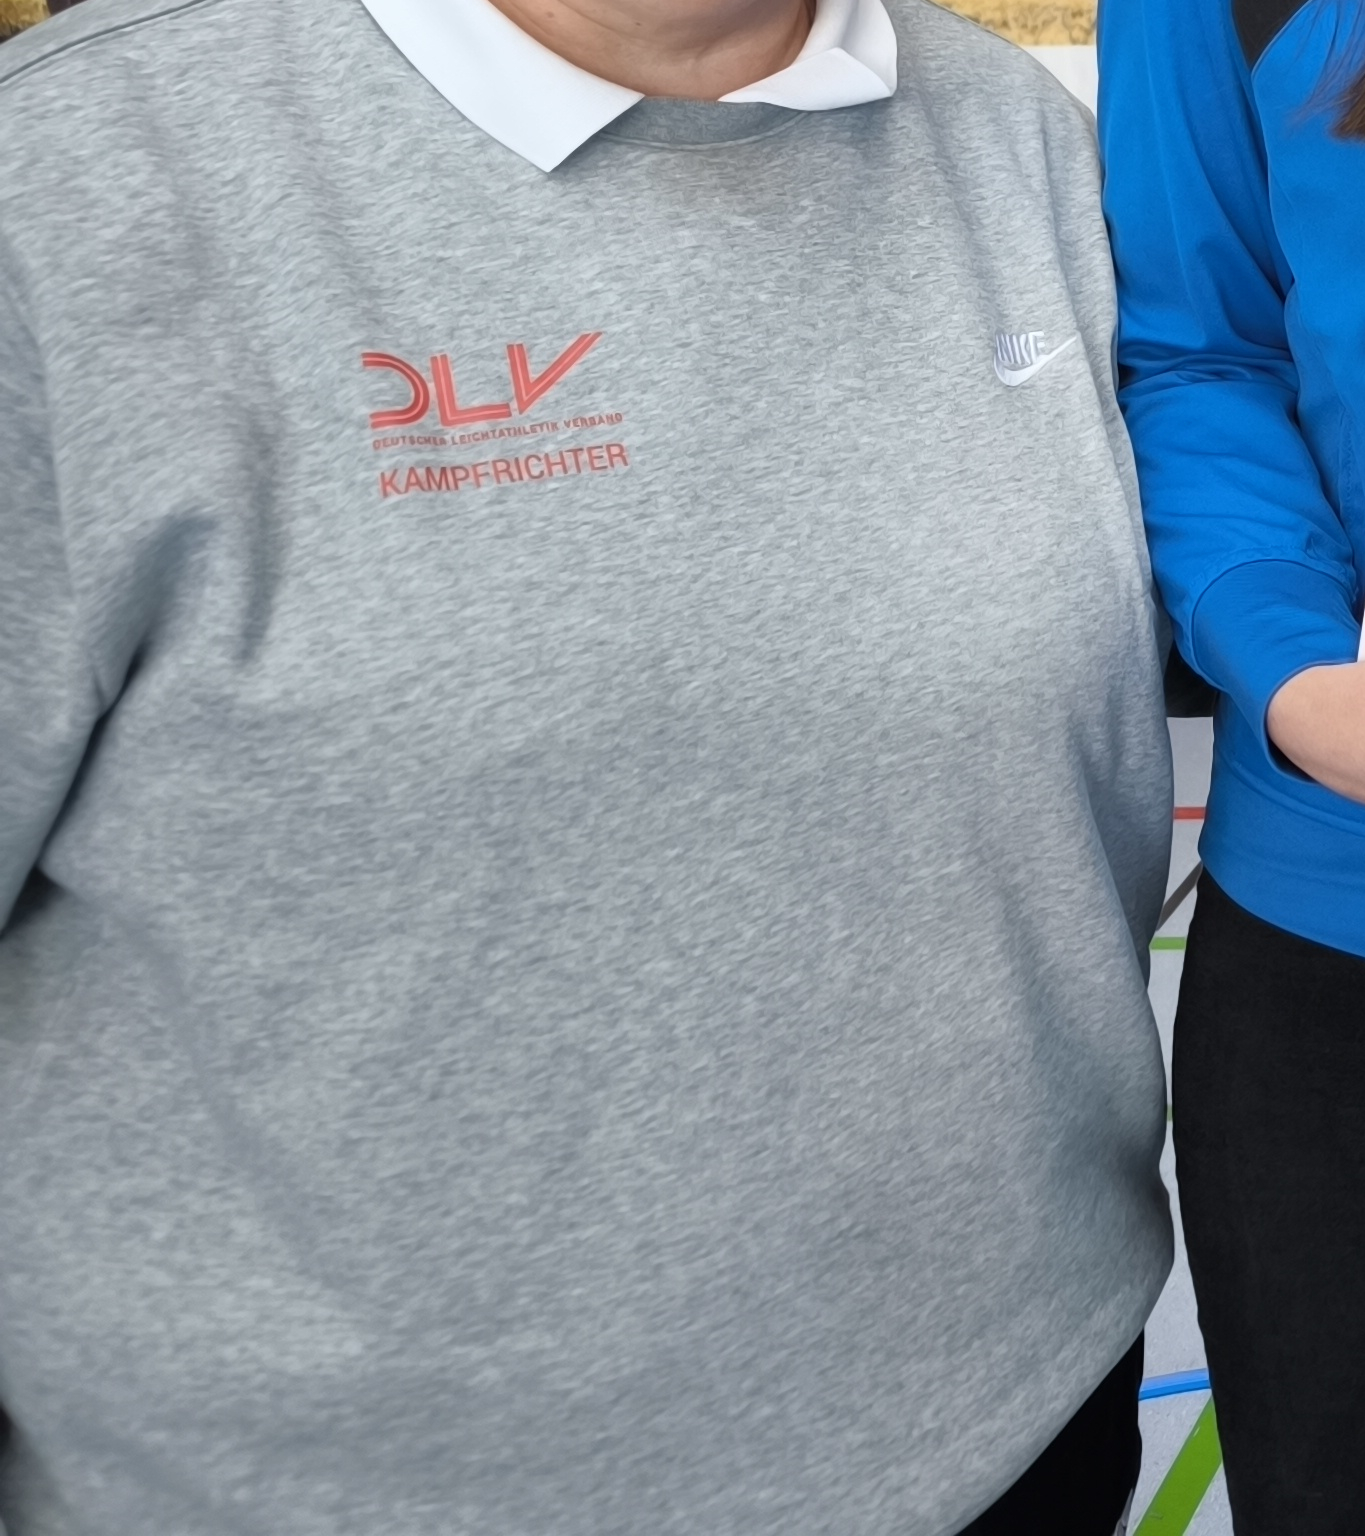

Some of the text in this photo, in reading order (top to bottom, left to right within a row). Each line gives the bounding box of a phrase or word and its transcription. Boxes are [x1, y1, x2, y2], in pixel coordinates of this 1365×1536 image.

[995, 330, 1046, 366] NIKE
[361, 331, 604, 429] DLV
[372, 411, 624, 451] DEUTSCHER LEICHTATHLETIK VERBAND
[379, 443, 629, 499] KAMPFRICHTER
